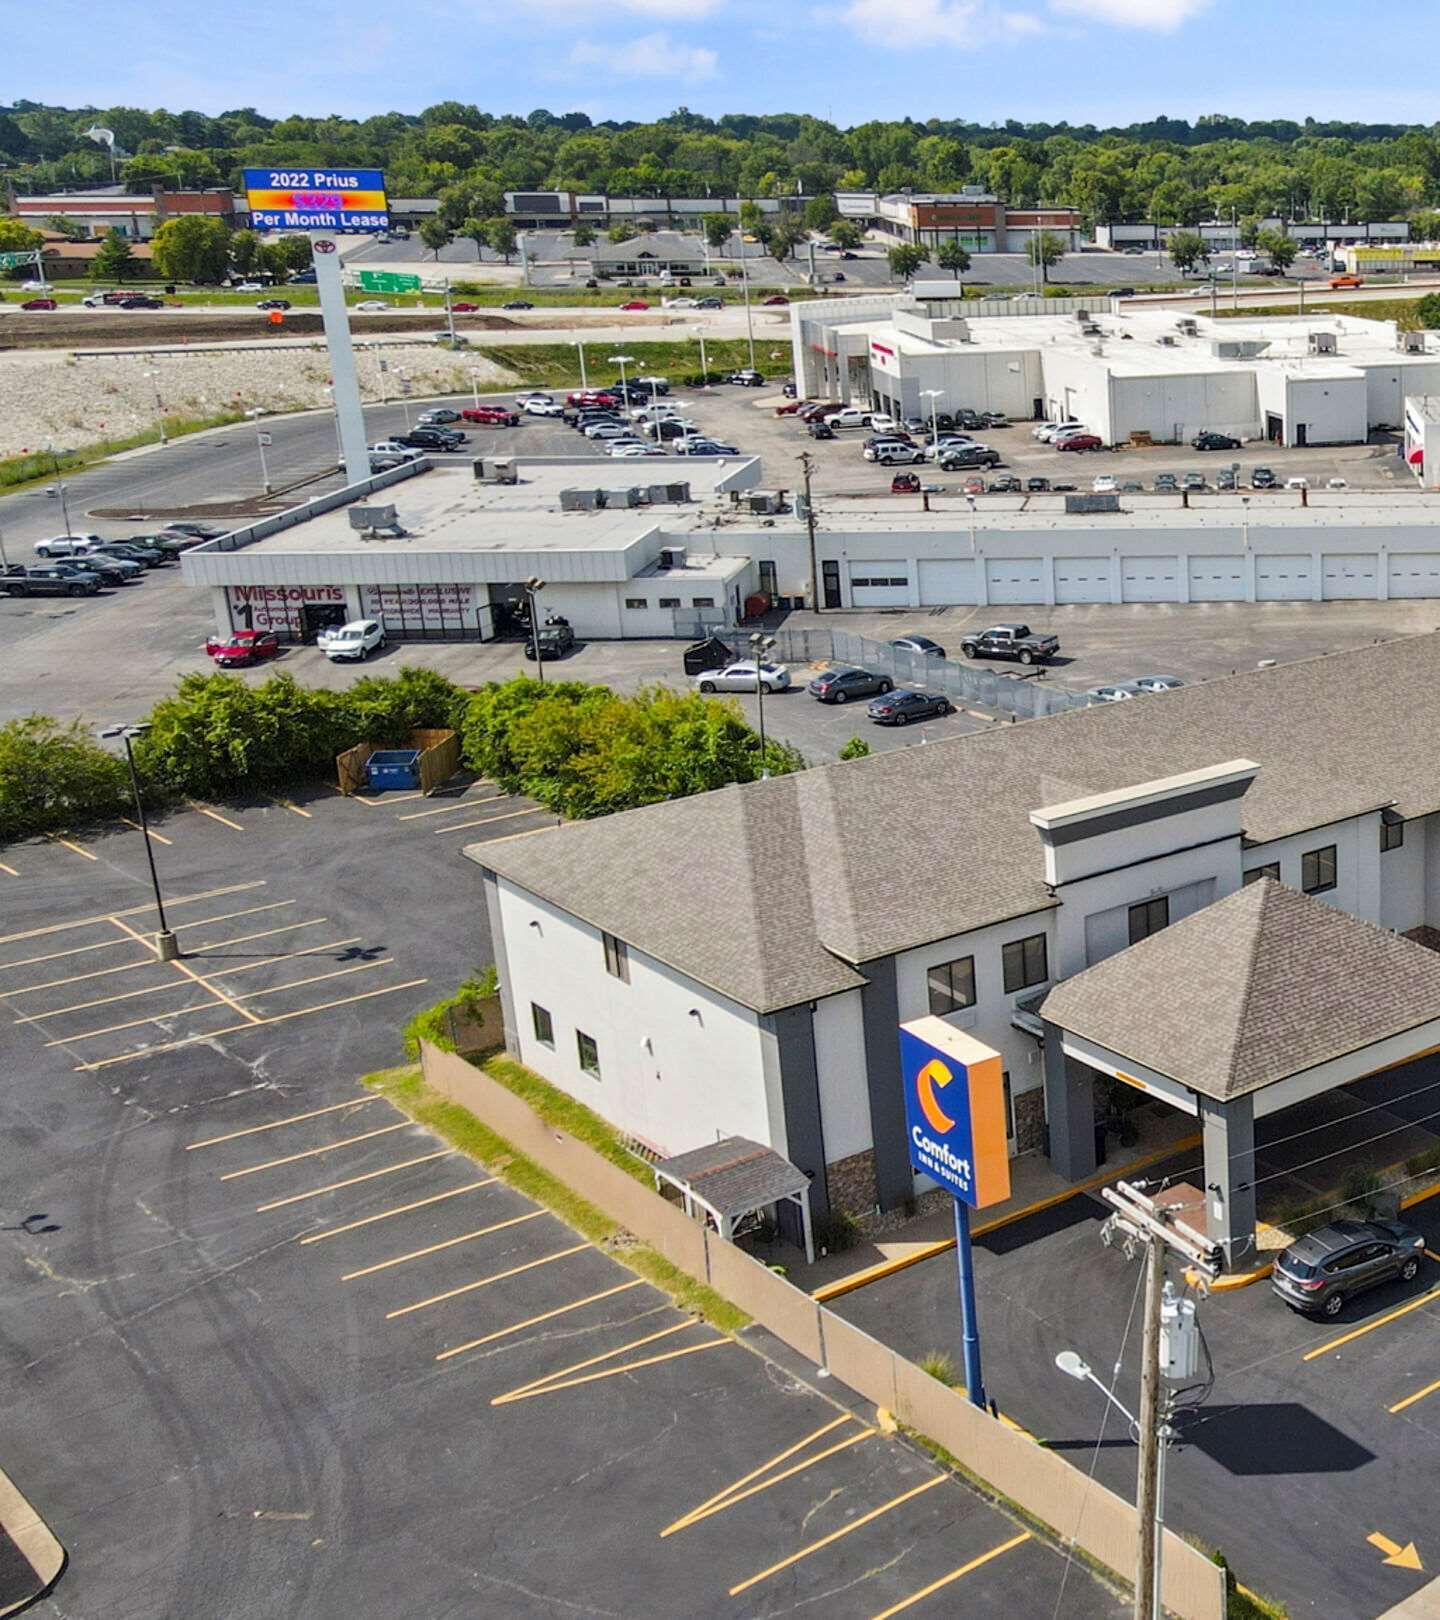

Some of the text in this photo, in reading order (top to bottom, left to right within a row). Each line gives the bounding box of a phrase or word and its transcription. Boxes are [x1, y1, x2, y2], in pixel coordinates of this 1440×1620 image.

[269, 173, 359, 187] 2022 Prius
[252, 212, 389, 226] Per Month Lease
[912, 1125, 971, 1180] Comfort
[918, 1151, 933, 1168] INN
[941, 1166, 968, 1192] SUITES
